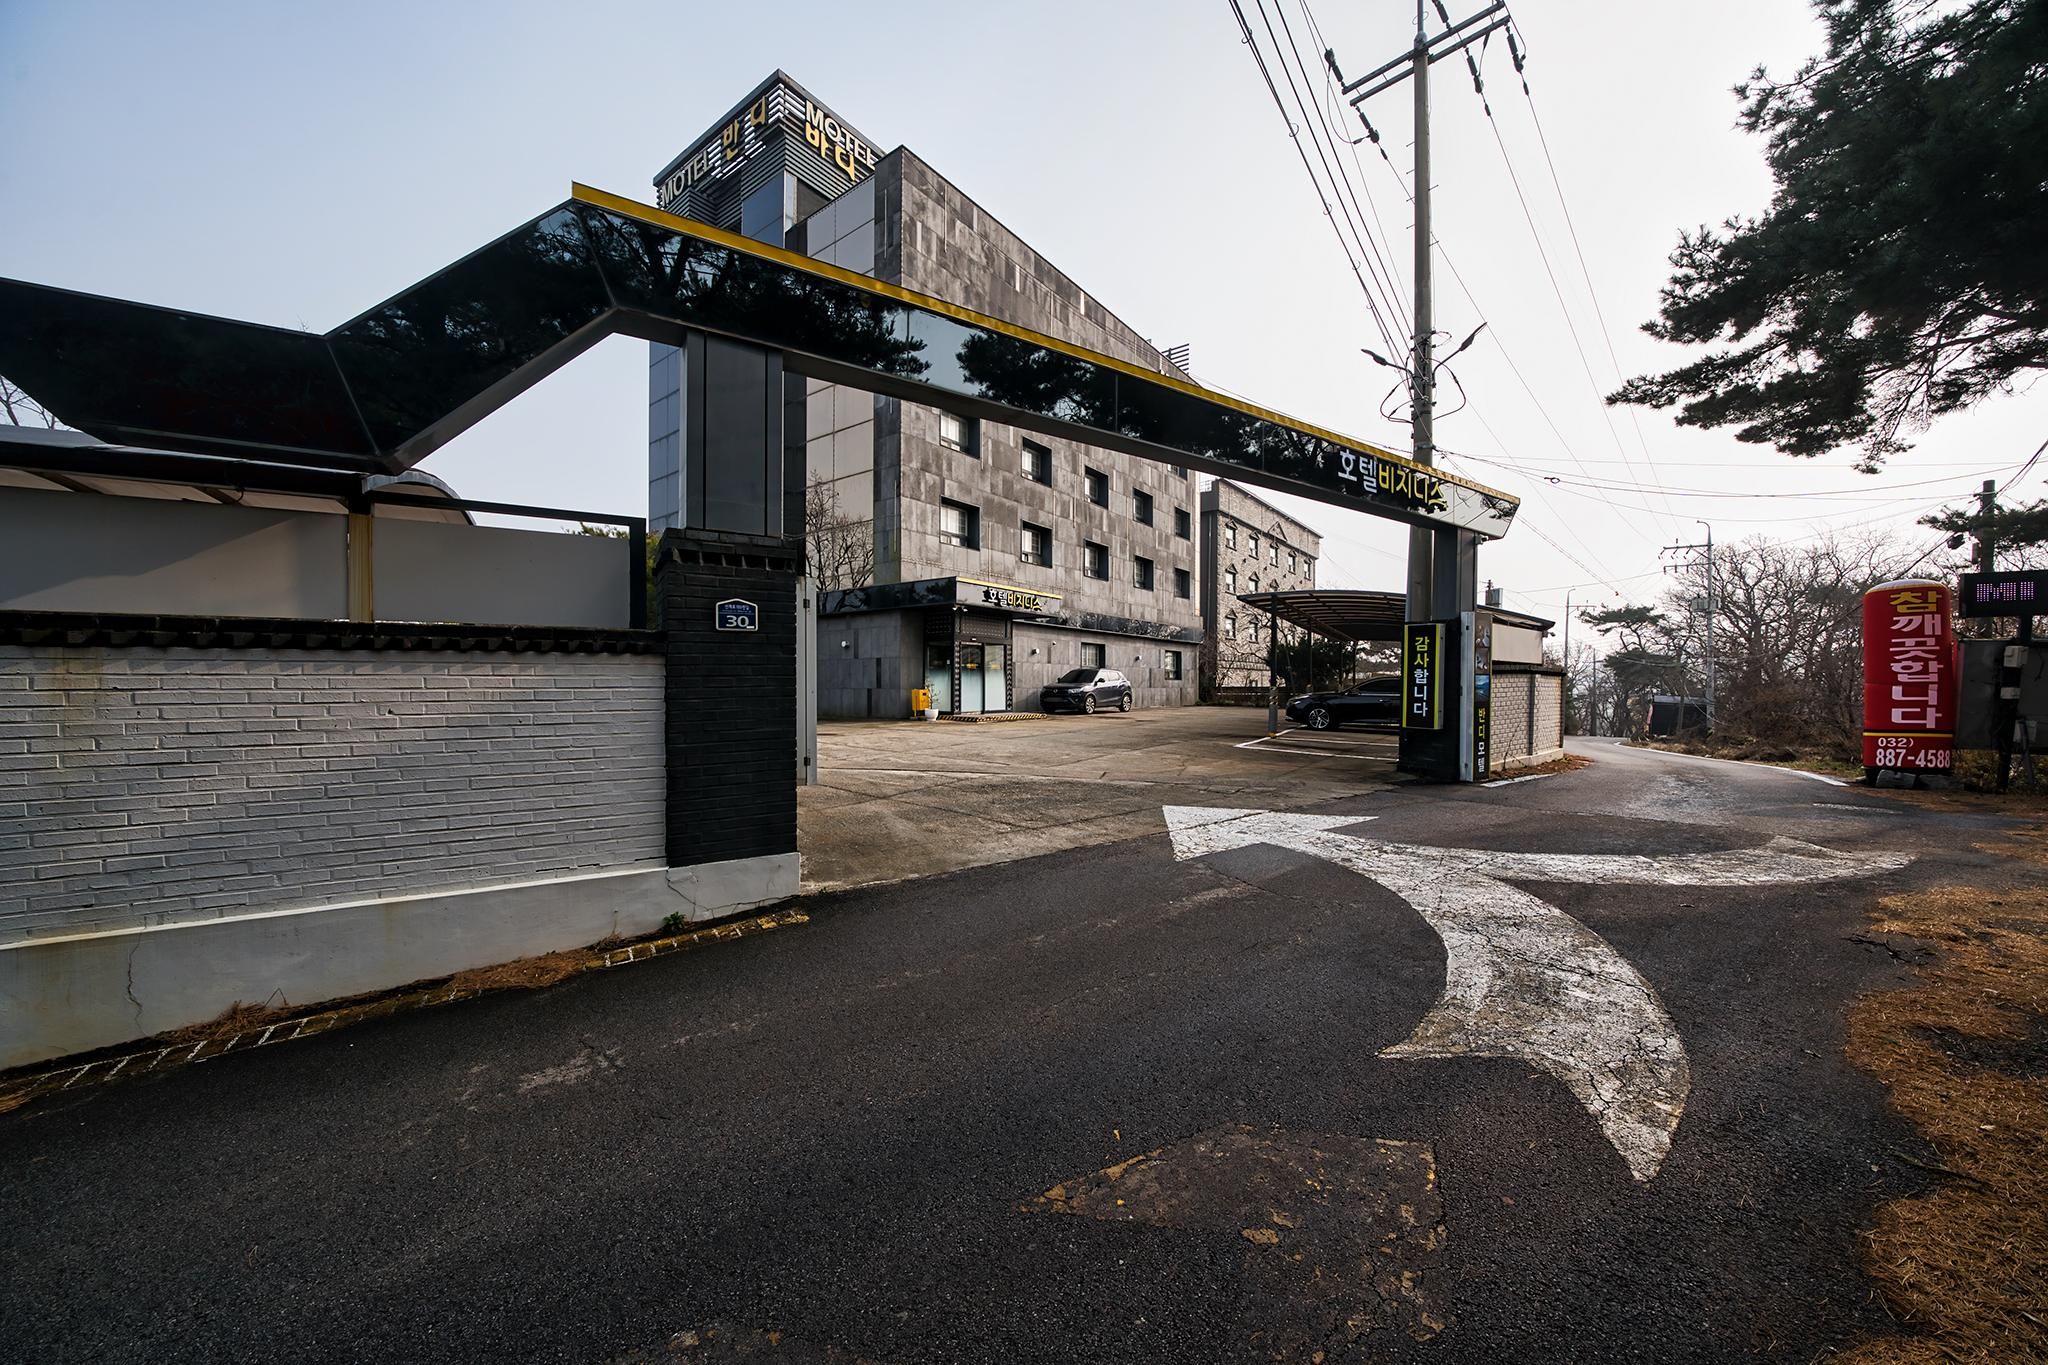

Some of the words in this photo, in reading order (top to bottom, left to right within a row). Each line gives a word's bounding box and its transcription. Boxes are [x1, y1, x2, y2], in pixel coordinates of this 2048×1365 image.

[806, 100, 875, 171] MOTEL
[661, 150, 713, 206] MOTEL
[726, 615, 749, 627] 30
[1413, 636, 1429, 717] 감사합니다
[1876, 749, 1950, 768] 887-4588
